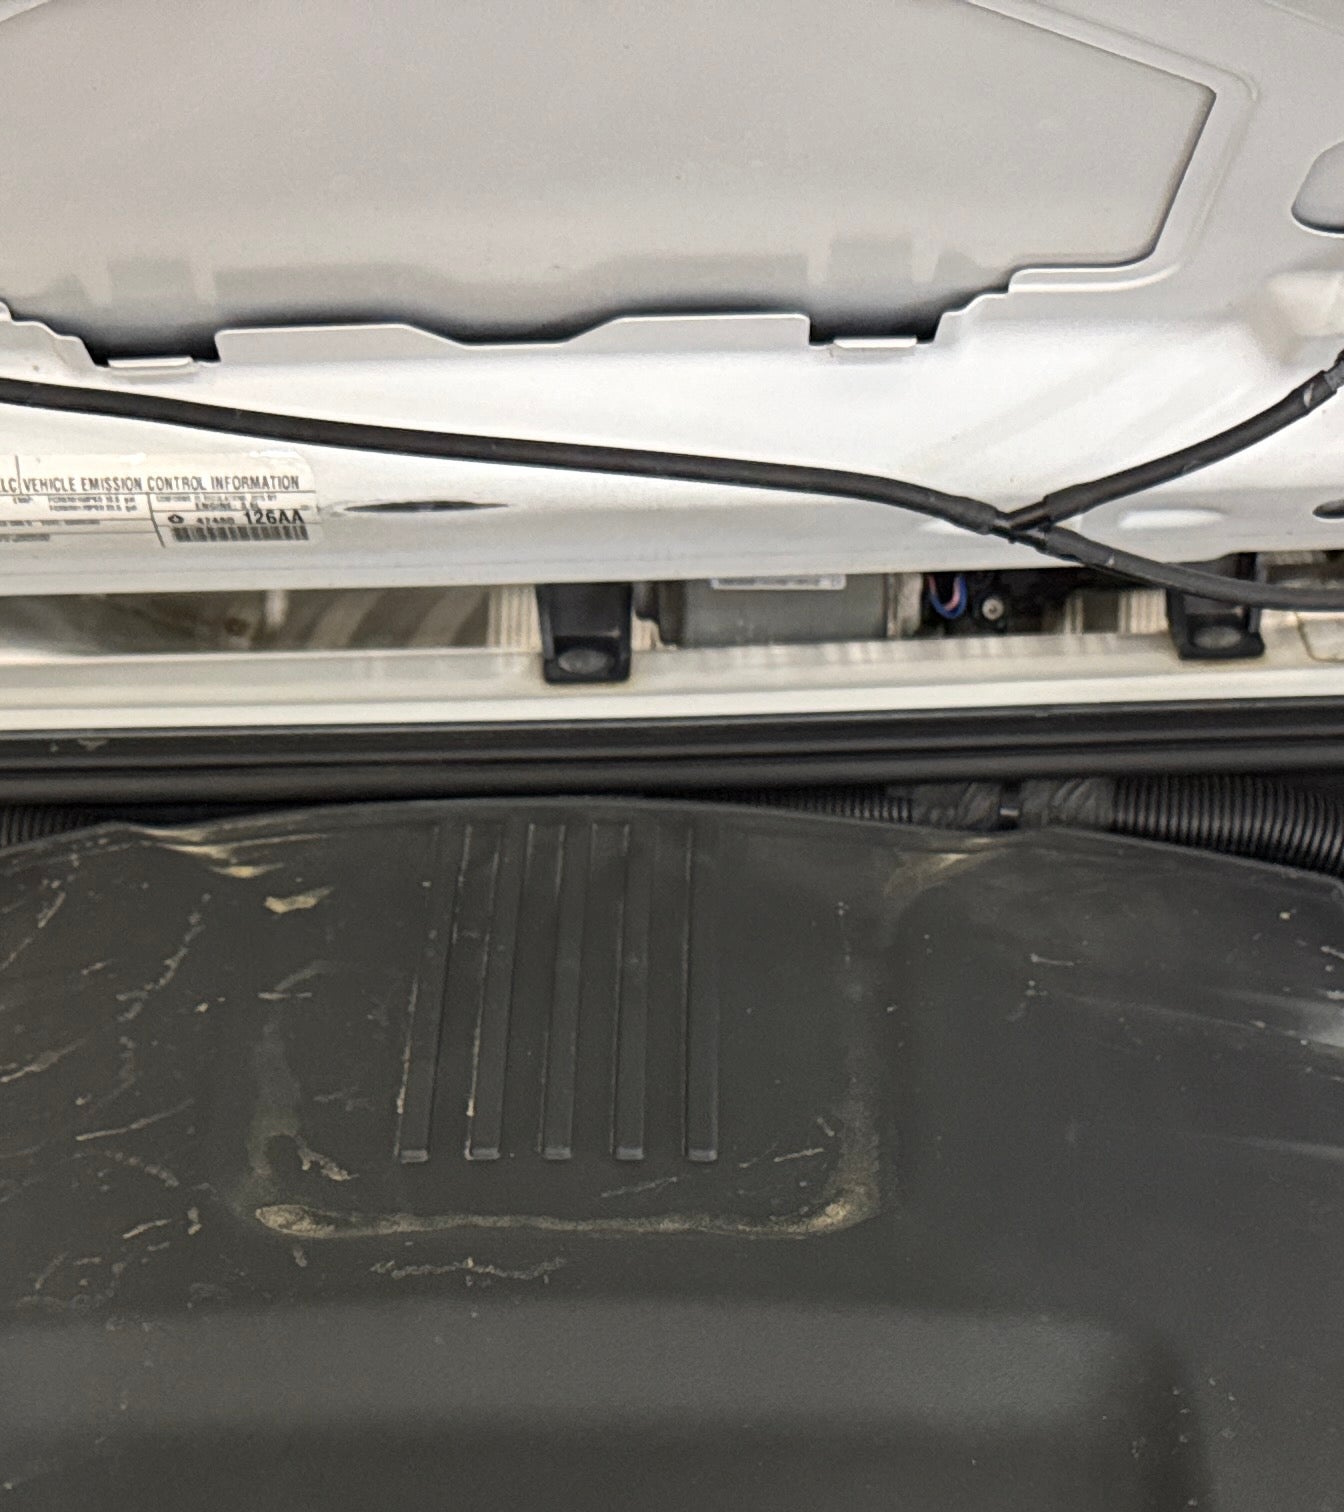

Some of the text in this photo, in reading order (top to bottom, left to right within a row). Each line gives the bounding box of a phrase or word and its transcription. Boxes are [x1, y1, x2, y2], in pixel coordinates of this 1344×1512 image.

[22, 475, 300, 493] VEHICLE EMISSION CONTROL INFORMATION
[243, 509, 305, 525] 126AA
